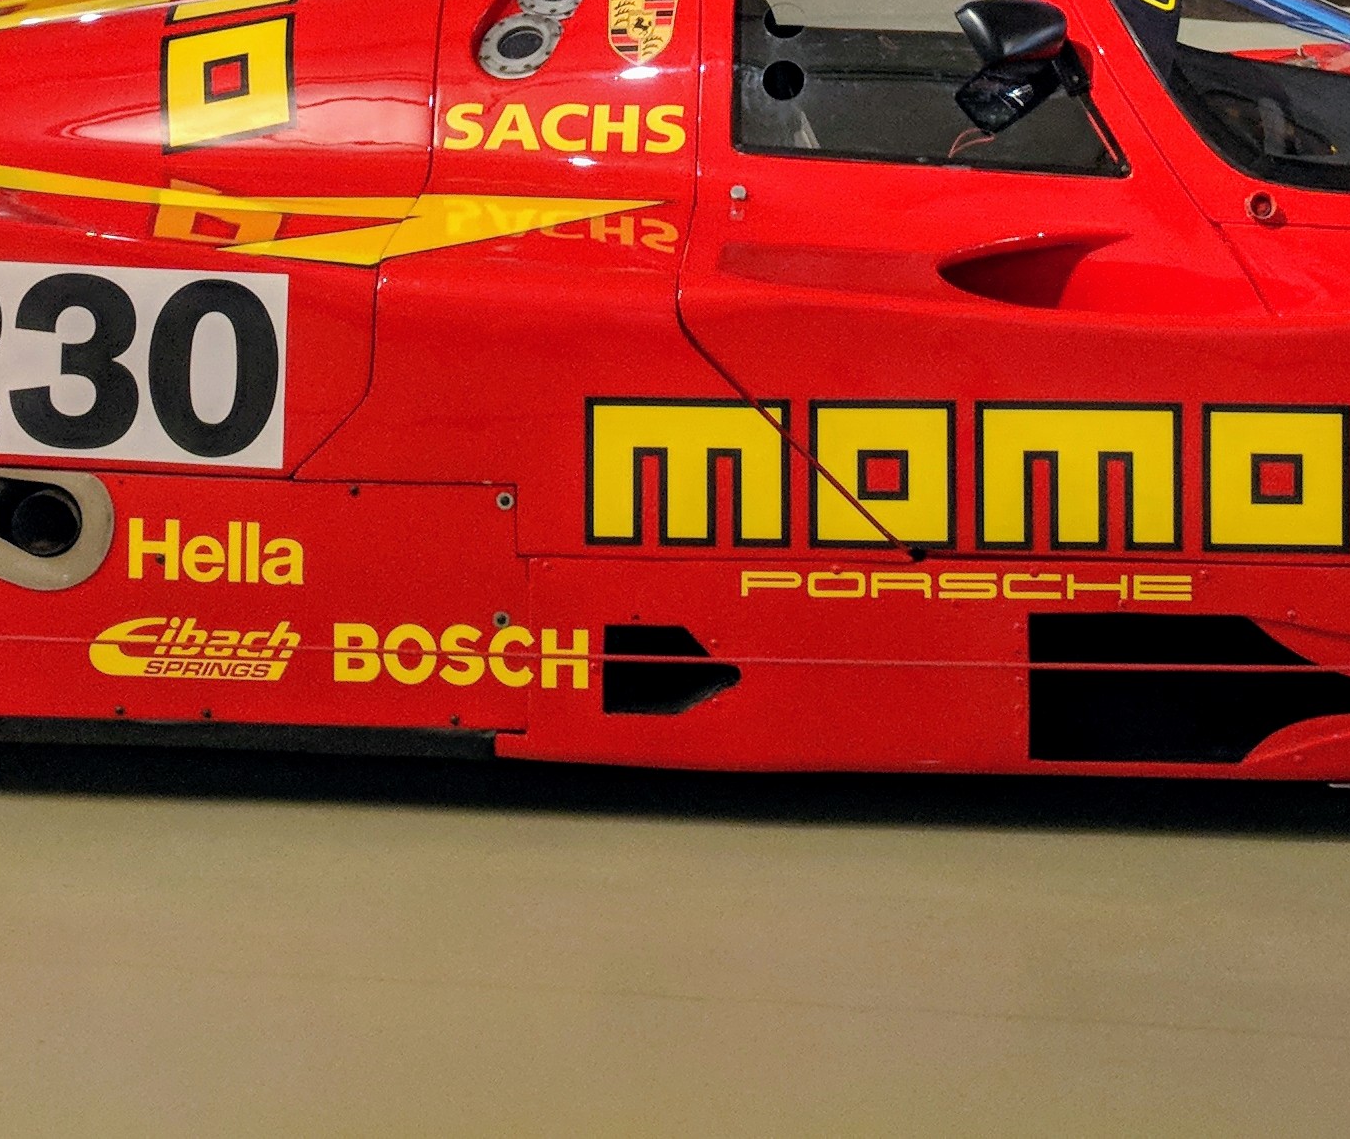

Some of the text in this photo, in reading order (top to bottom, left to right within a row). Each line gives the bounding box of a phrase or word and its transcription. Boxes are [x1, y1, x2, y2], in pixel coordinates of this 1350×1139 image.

[442, 102, 687, 154] SACHS
[128, 517, 304, 585] Hella
[740, 570, 1193, 601] PORSCHE
[90, 615, 301, 666] Eibach
[333, 622, 589, 690] BOSCH
[143, 660, 272, 679] SPRINGS
